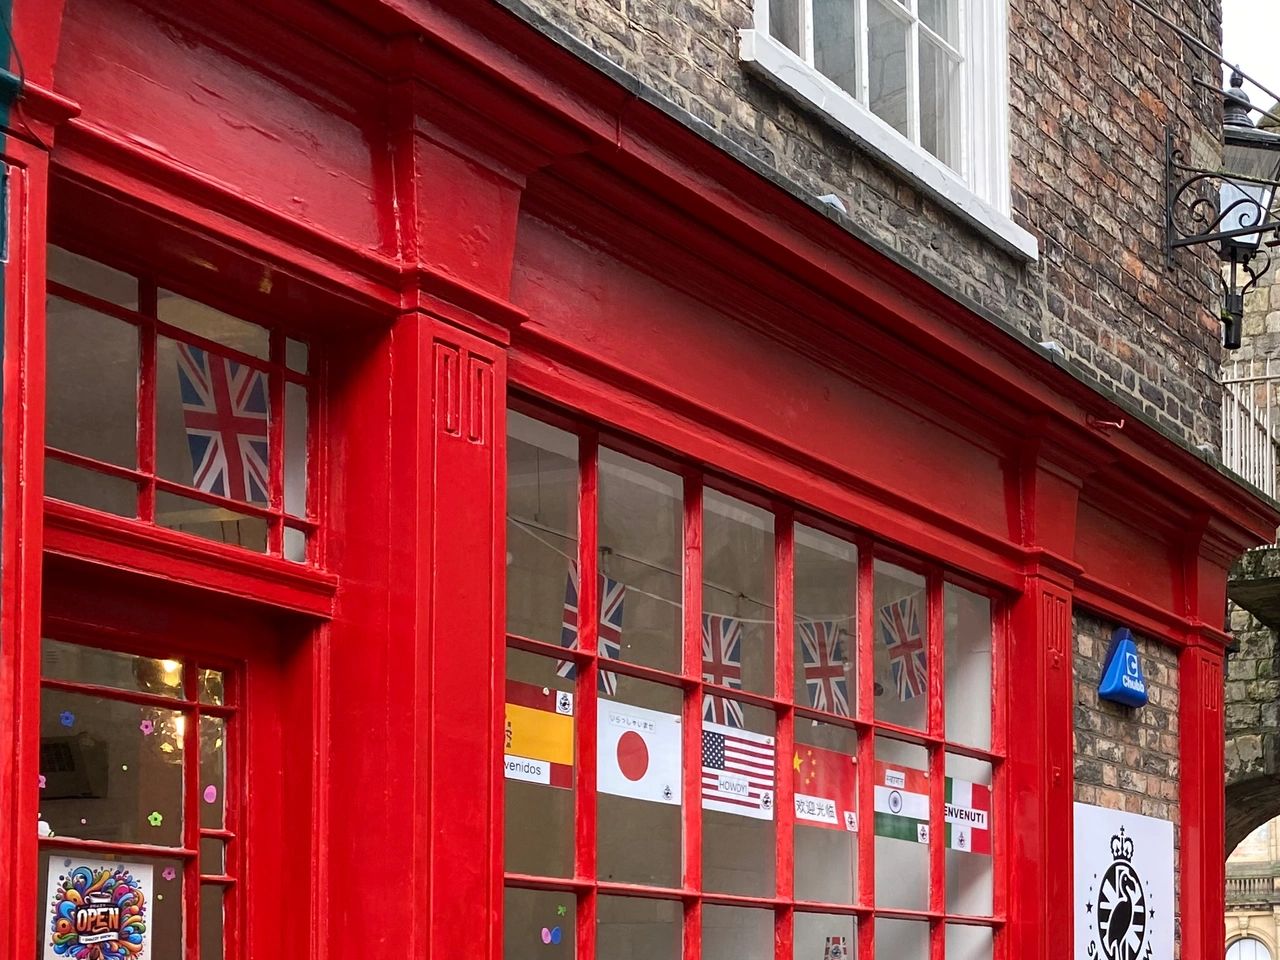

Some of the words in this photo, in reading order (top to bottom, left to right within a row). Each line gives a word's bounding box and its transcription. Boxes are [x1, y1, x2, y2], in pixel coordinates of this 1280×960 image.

[1122, 674, 1145, 693] Chubb
[504, 759, 542, 776] venidos
[796, 799, 836, 818] 欢迎光临
[944, 805, 984, 824] ENVENUTI
[77, 908, 119, 932] OPEN
